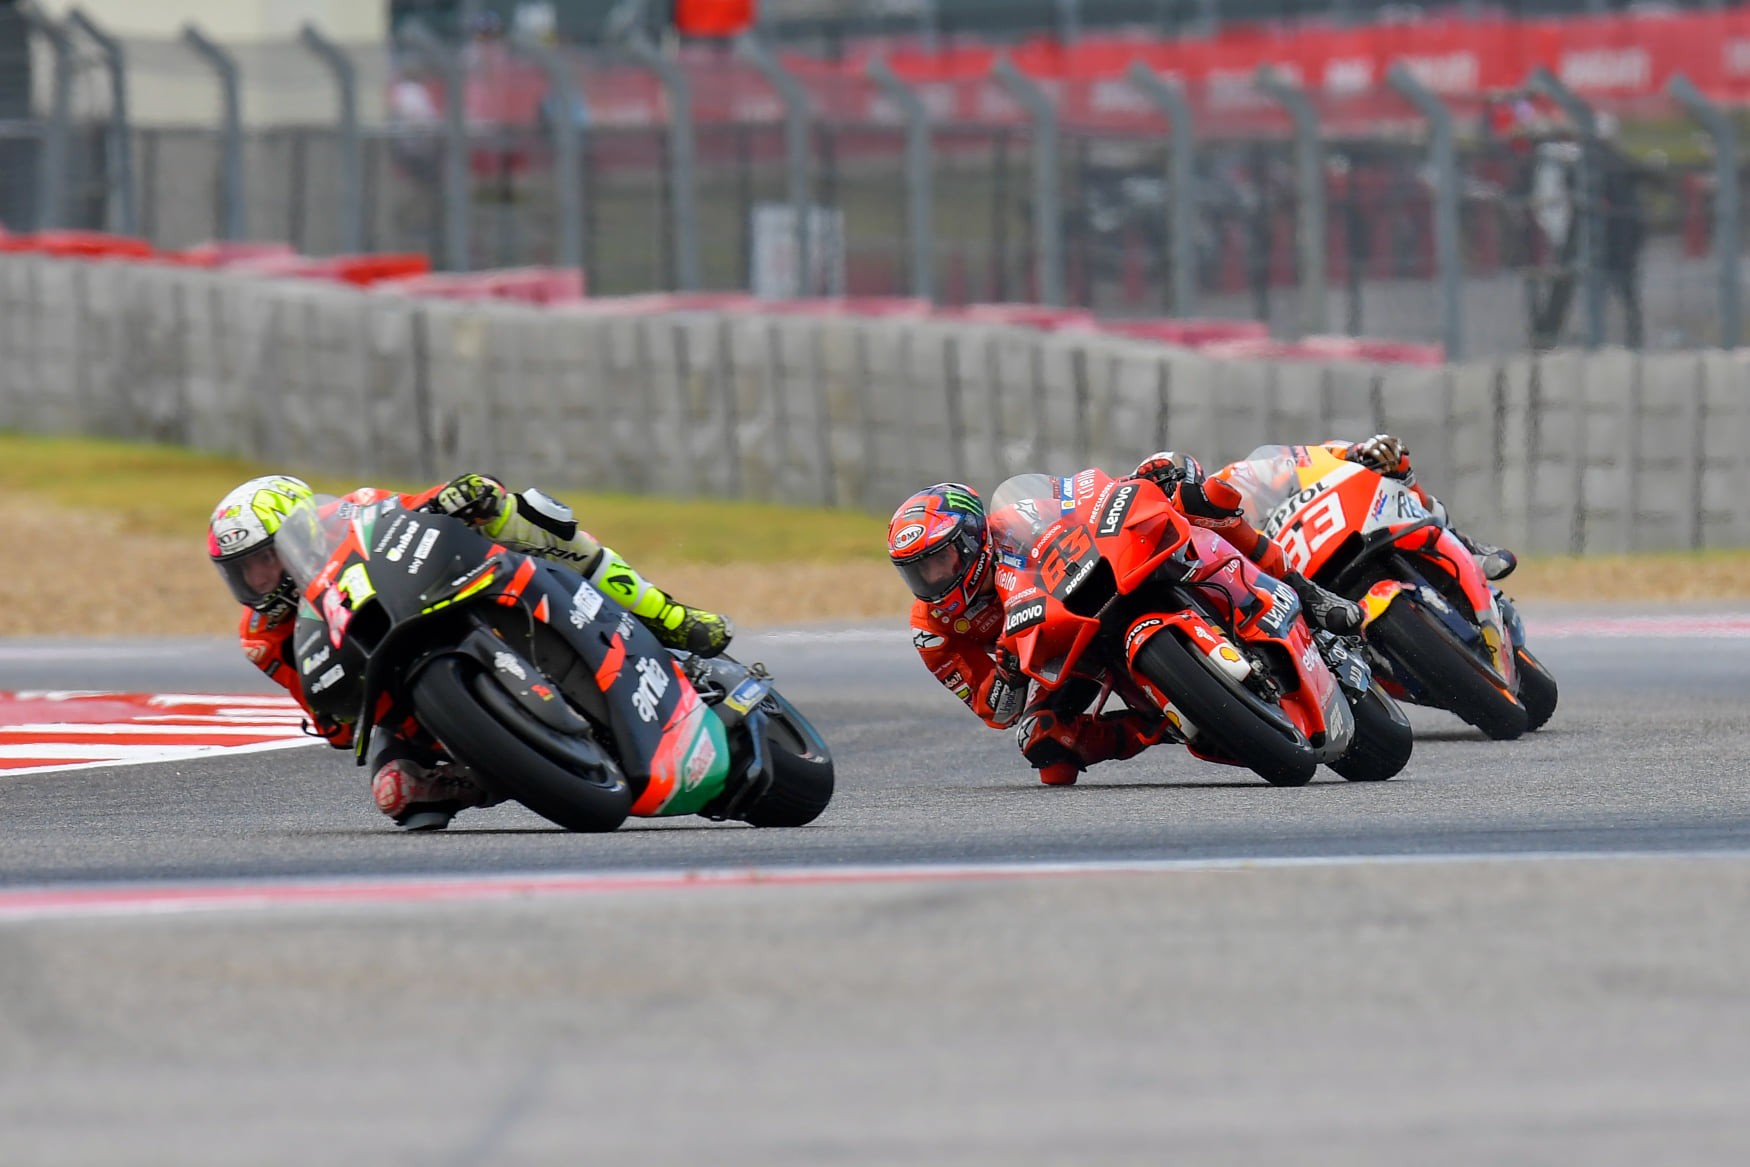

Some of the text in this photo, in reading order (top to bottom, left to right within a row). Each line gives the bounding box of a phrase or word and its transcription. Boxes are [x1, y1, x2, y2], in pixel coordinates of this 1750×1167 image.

[1100, 486, 1132, 534] Lenovo
[1265, 481, 1330, 540] EPSOL
[969, 553, 986, 586] Lenovo
[1040, 525, 1092, 594] 63
[1065, 560, 1095, 595] DUCATI
[1006, 605, 1043, 631] Lenovo
